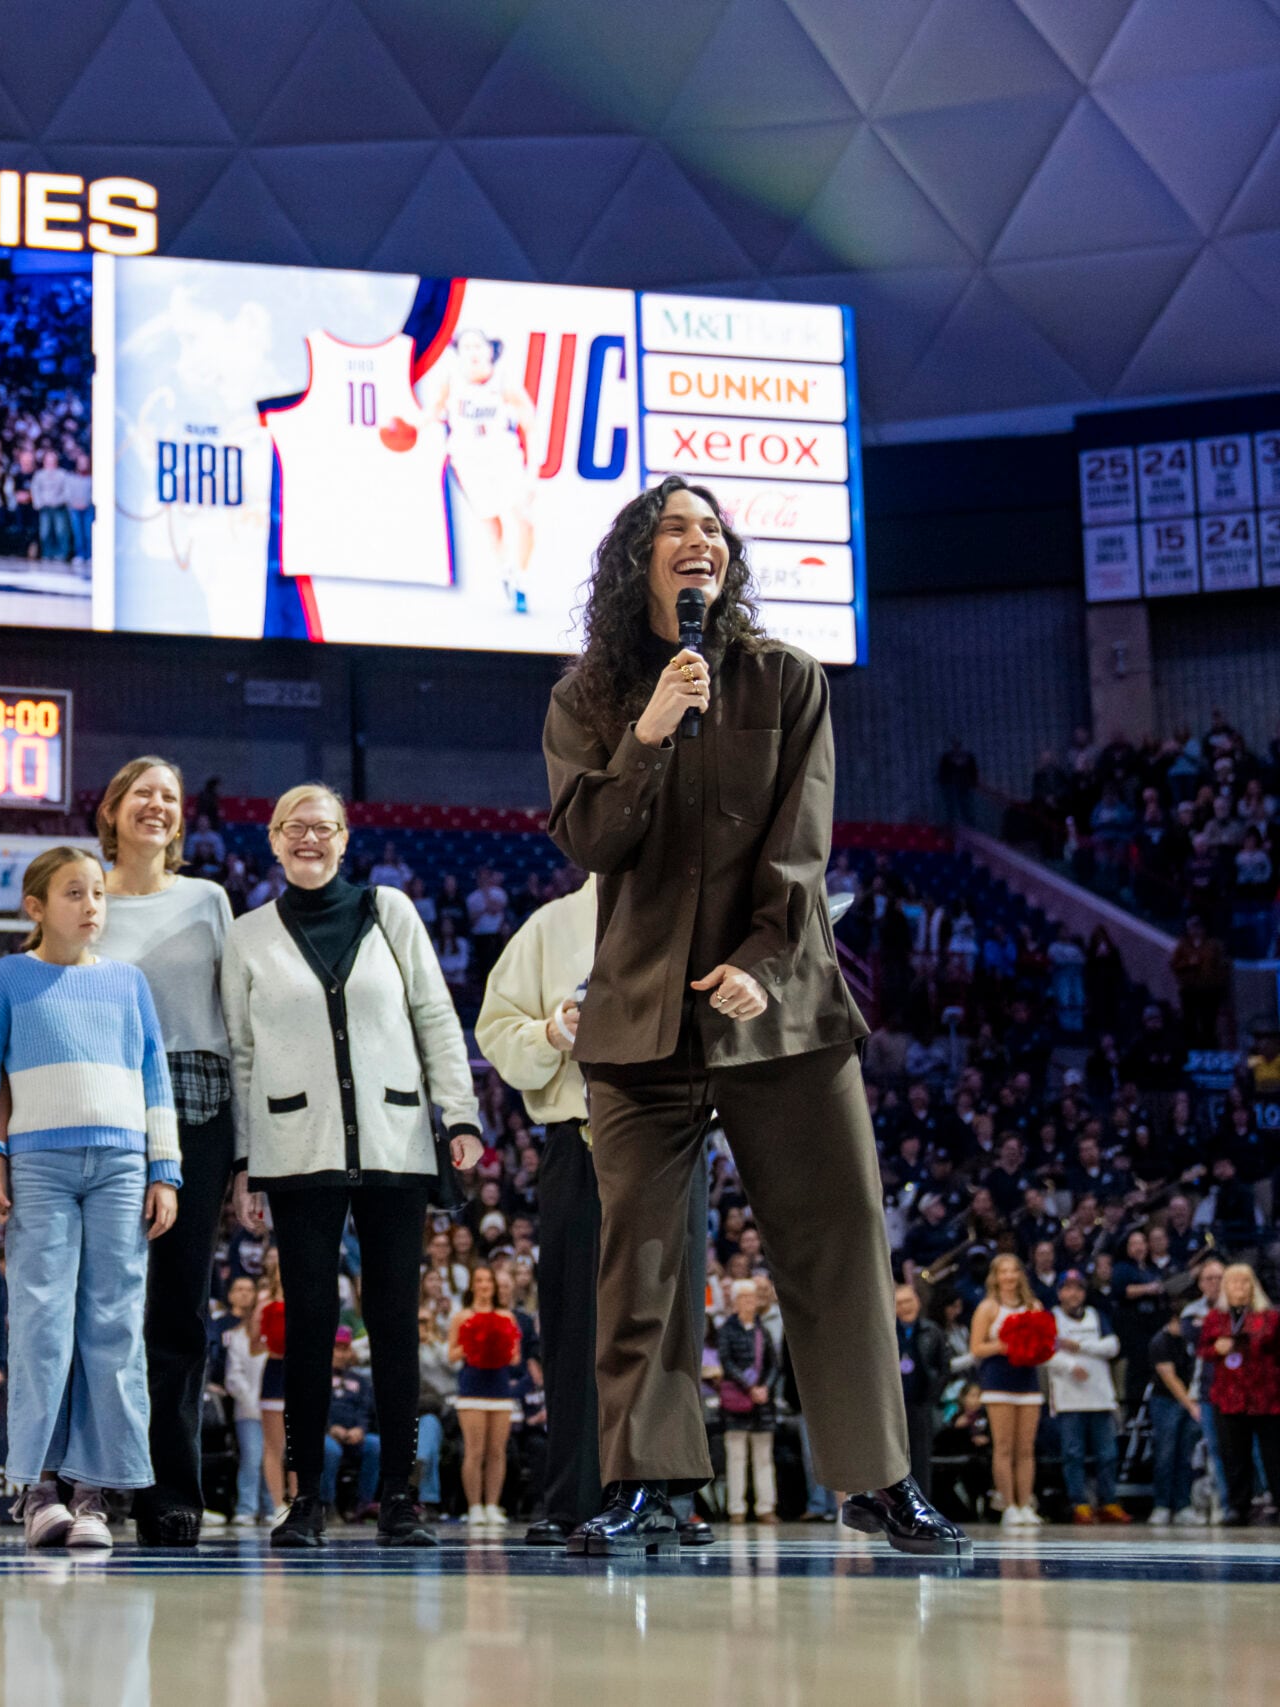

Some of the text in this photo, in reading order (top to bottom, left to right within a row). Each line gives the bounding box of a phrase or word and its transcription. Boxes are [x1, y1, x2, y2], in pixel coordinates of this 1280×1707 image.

[347, 381, 377, 427] 10
[673, 428, 820, 467] xerox
[157, 440, 243, 506] BIRD
